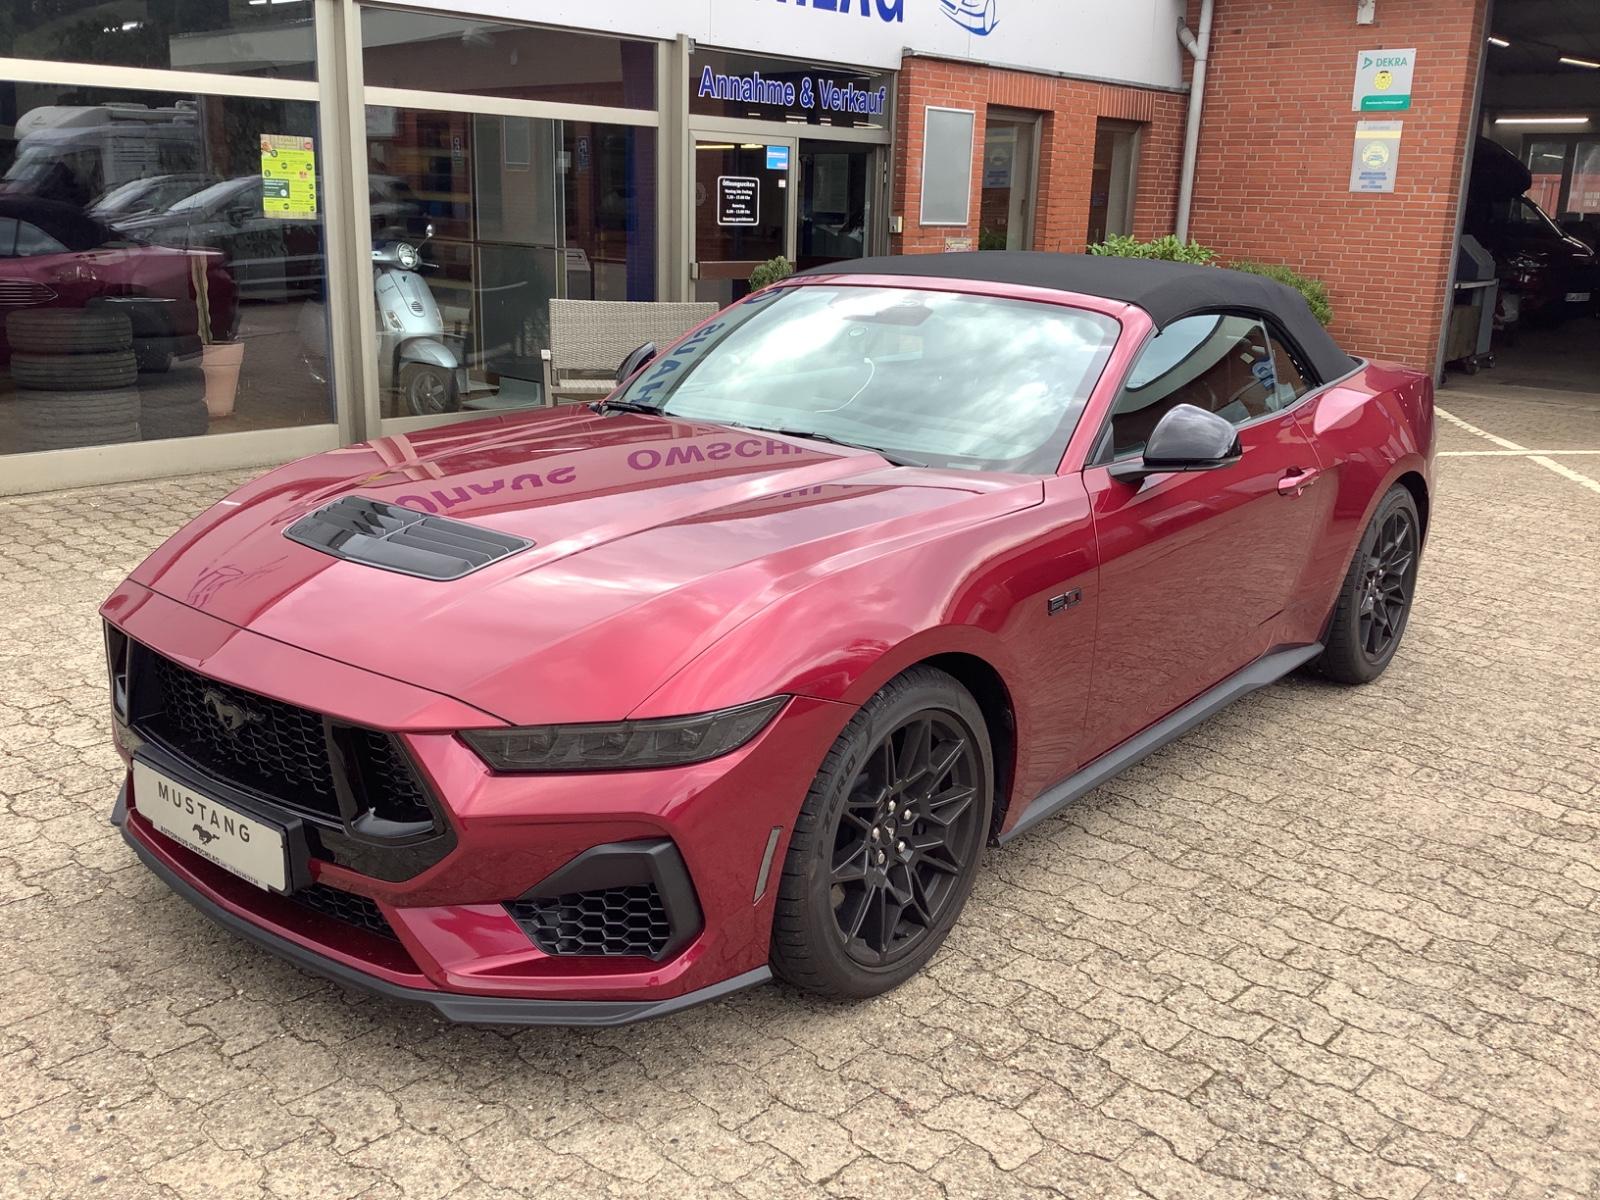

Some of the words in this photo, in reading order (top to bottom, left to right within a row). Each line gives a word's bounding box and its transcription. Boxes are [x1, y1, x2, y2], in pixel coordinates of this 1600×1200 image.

[1376, 56, 1407, 67] DEKRA
[698, 65, 795, 107] Annahme
[800, 76, 814, 109] &
[818, 79, 886, 115] Verkauf
[158, 781, 250, 843] MUSTANG
